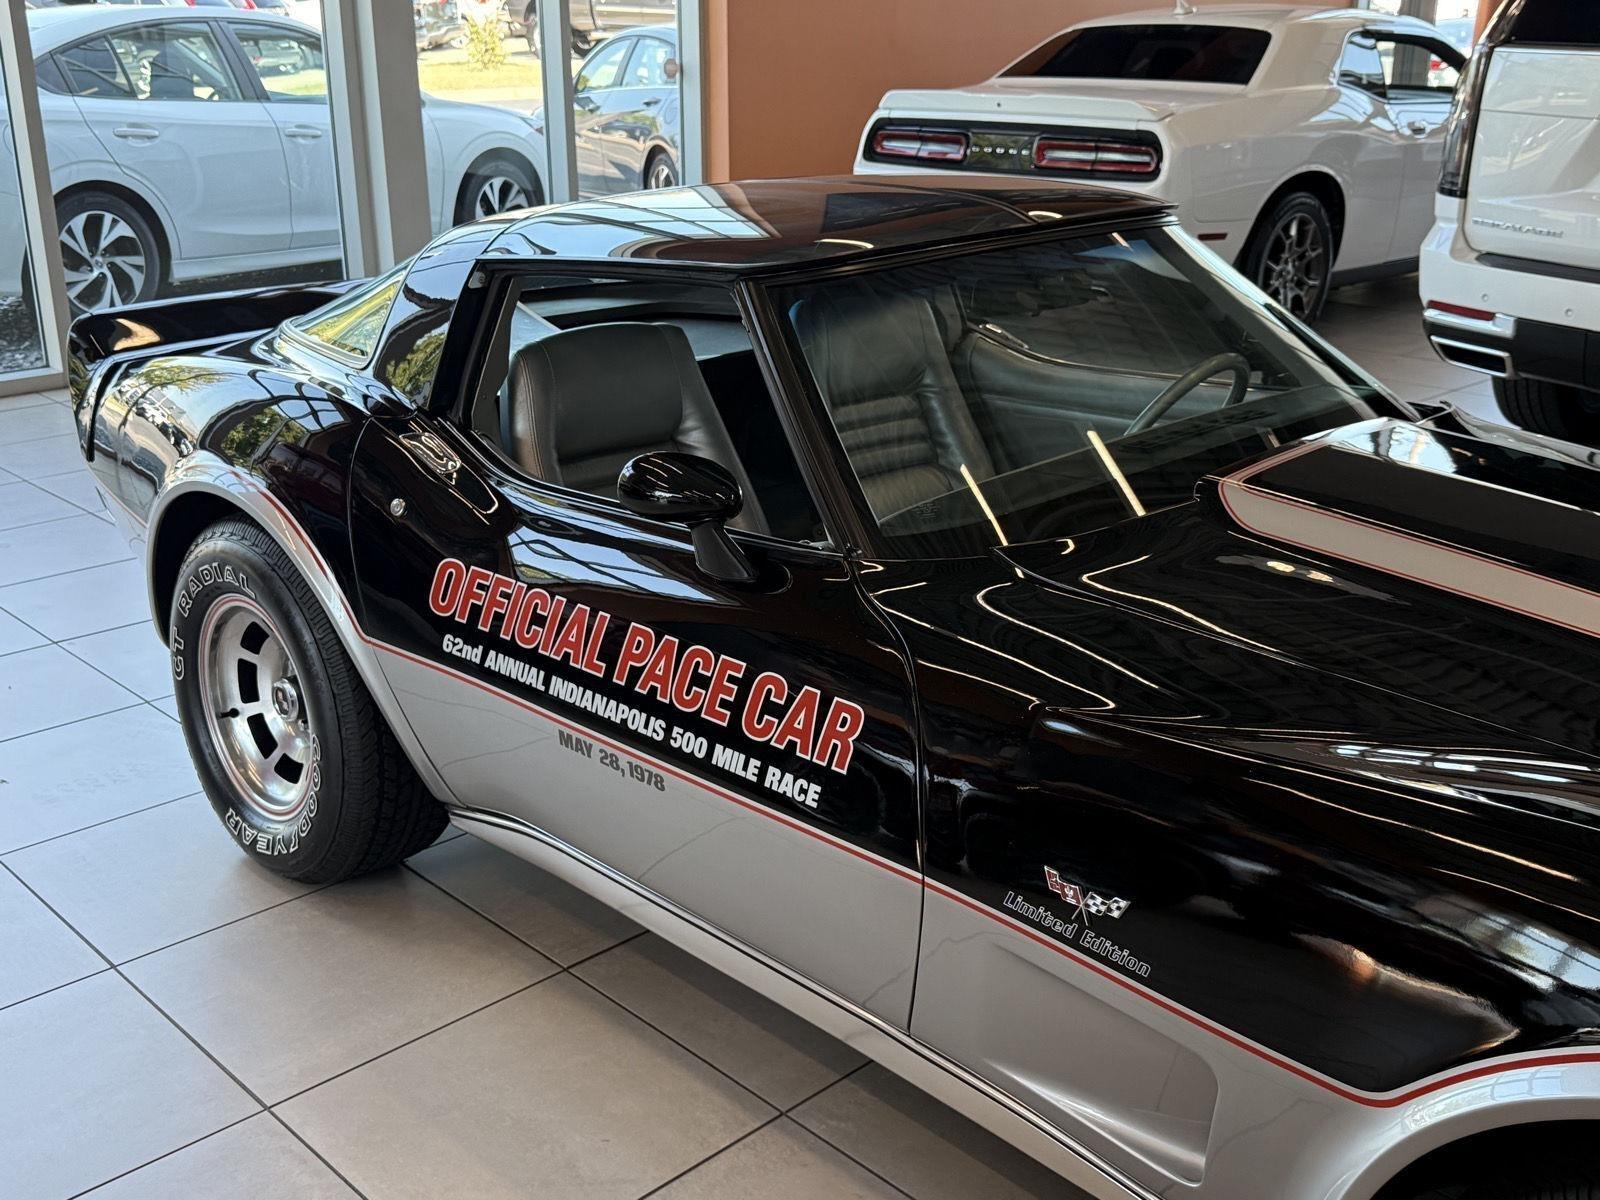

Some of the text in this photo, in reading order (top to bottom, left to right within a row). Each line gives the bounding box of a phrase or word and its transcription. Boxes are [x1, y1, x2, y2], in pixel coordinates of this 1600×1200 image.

[178, 562, 256, 618] RADIAL
[429, 558, 865, 774] OFFICIAL PACE CAR
[442, 633, 822, 809] 62nd ANNUAL INDIANAPOLIS 500 MILE RACE
[558, 729, 594, 759] MAY
[225, 734, 320, 856] GOODYEAR
[1003, 891, 1151, 977] Limited Edition
